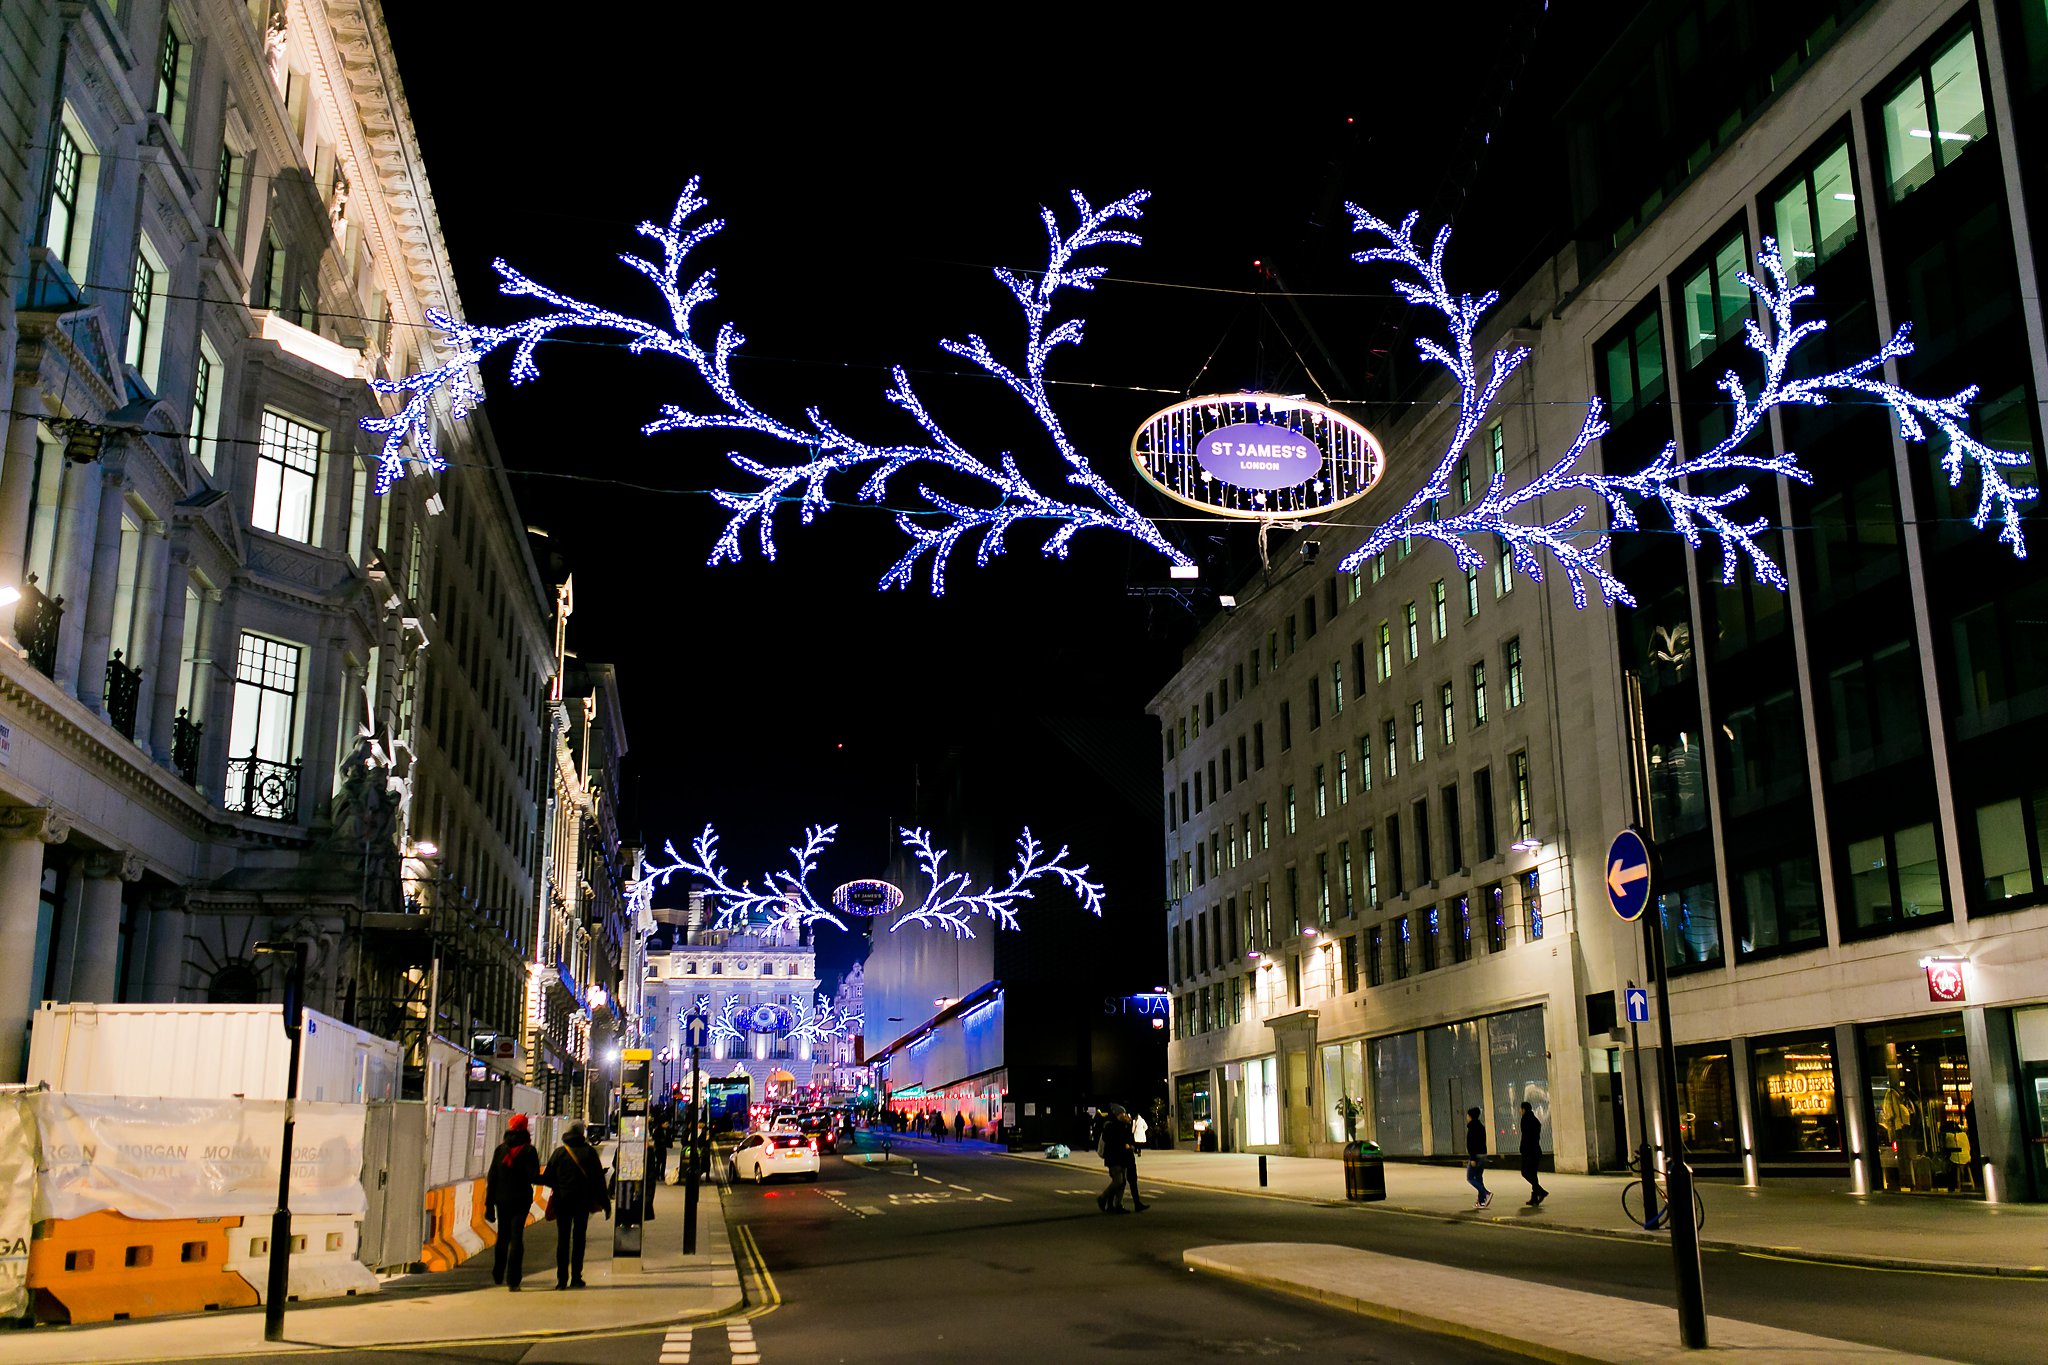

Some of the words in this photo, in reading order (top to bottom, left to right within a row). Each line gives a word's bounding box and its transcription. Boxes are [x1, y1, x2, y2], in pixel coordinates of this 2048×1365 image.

[1211, 442, 1233, 456] ST
[1236, 443, 1307, 459] JAMES'S
[1240, 461, 1280, 471] LONDON
[1104, 996, 1131, 1014] ST
[1138, 996, 1166, 1014] JA
[1790, 1096, 1826, 1109] London
[117, 1145, 188, 1159] MORGAN
[204, 1145, 271, 1160] MORGAN
